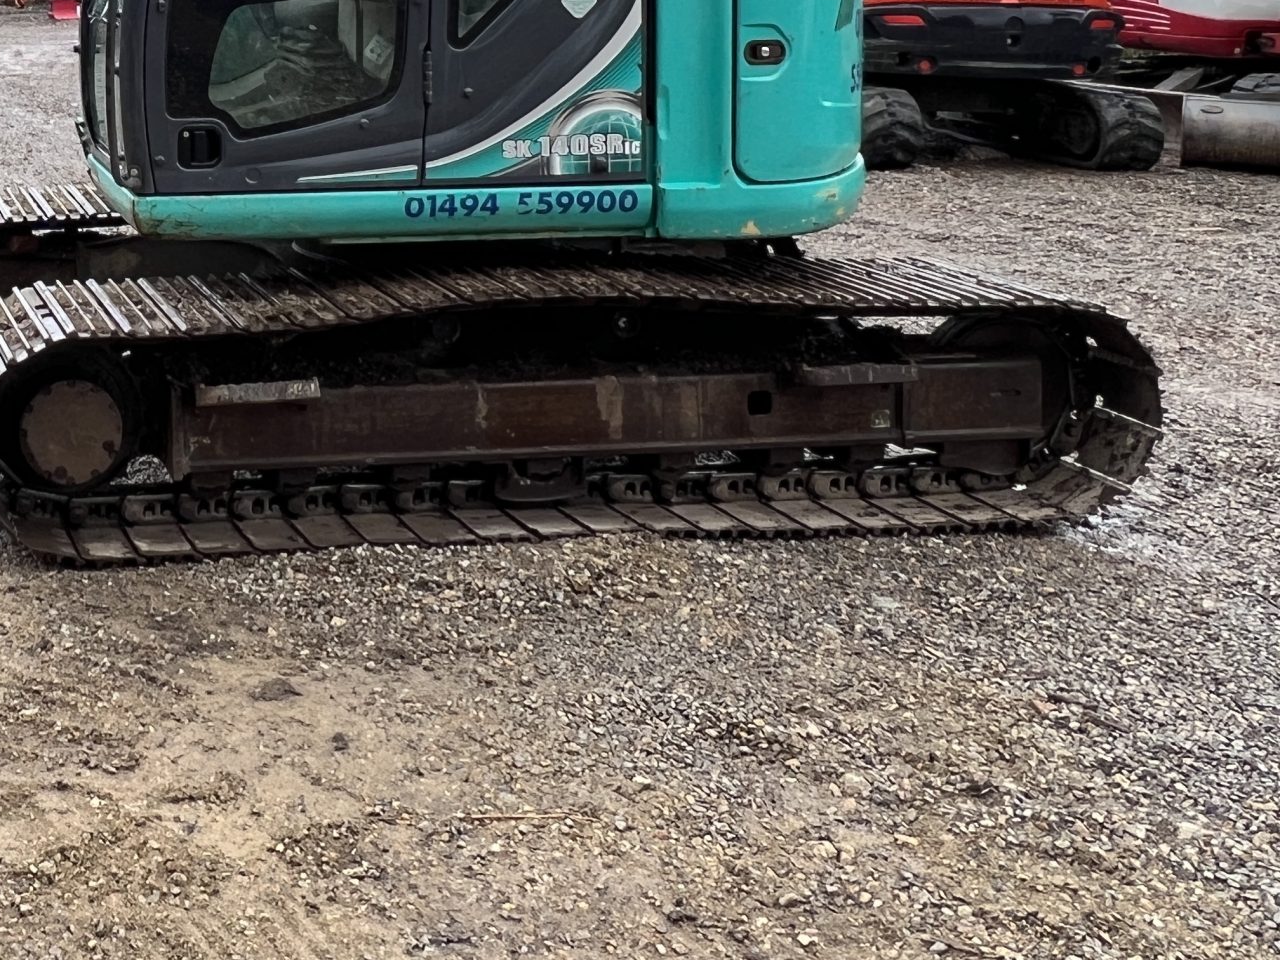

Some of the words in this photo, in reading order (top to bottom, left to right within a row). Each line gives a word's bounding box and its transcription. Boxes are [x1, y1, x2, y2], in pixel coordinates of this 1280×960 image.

[501, 139, 533, 159] SK
[404, 192, 500, 218] 01494
[517, 189, 639, 215] 559900
